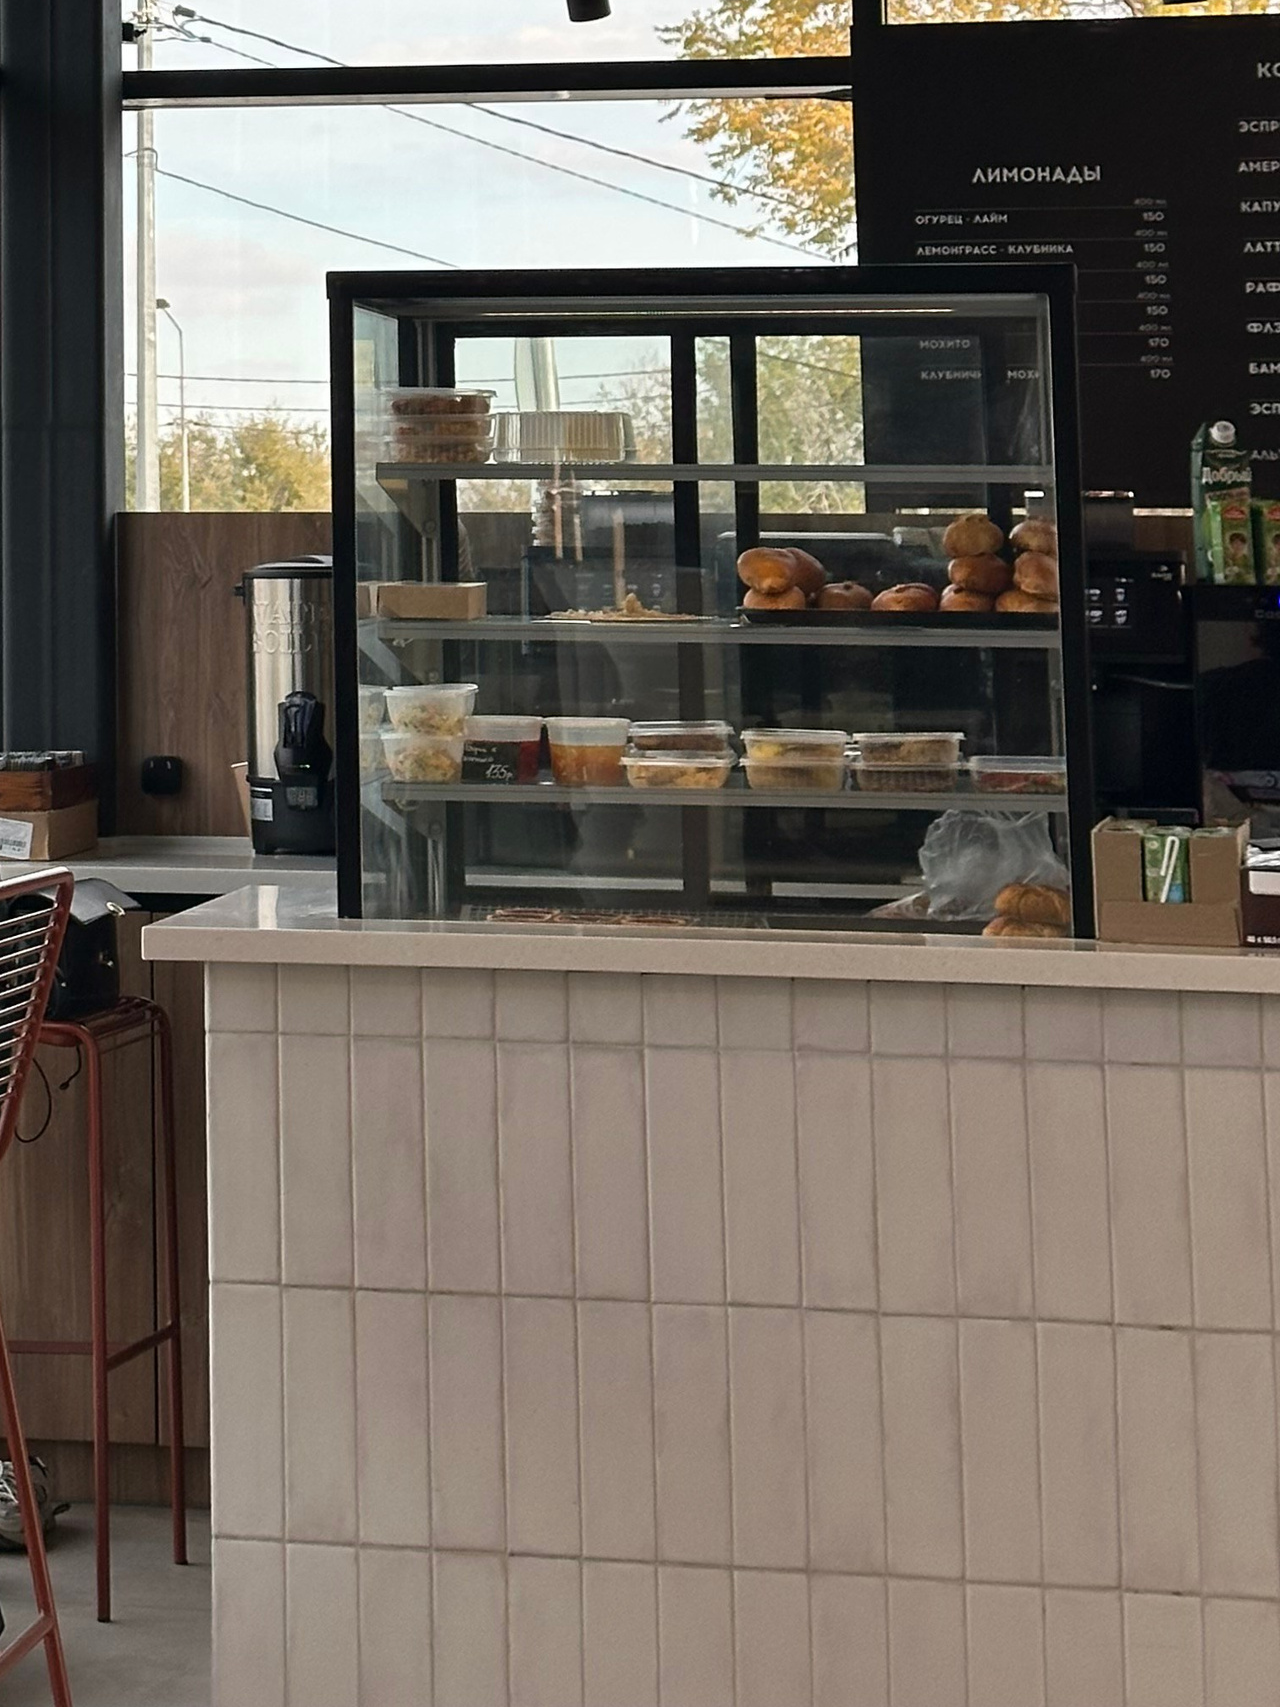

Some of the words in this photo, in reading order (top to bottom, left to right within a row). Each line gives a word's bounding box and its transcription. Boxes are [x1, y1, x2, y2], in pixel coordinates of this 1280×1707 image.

[1238, 160, 1280, 173] АМЕР
[972, 165, 1101, 184] ЛИМОНАДЫ
[915, 214, 963, 225] ОГУРЕЦ
[973, 212, 1008, 223] ЛАЙМ
[1142, 211, 1165, 222] 150
[916, 245, 997, 256] ЛЕМОНГРАСС
[1008, 244, 1074, 254] КЛУБНИКА
[1143, 242, 1166, 253] 150
[1145, 274, 1167, 285] 150
[1245, 281, 1280, 294] РАФ
[1146, 305, 1169, 316] 150
[919, 339, 971, 349] МОХИТО
[1148, 337, 1170, 348] 170
[1150, 368, 1172, 379] 170
